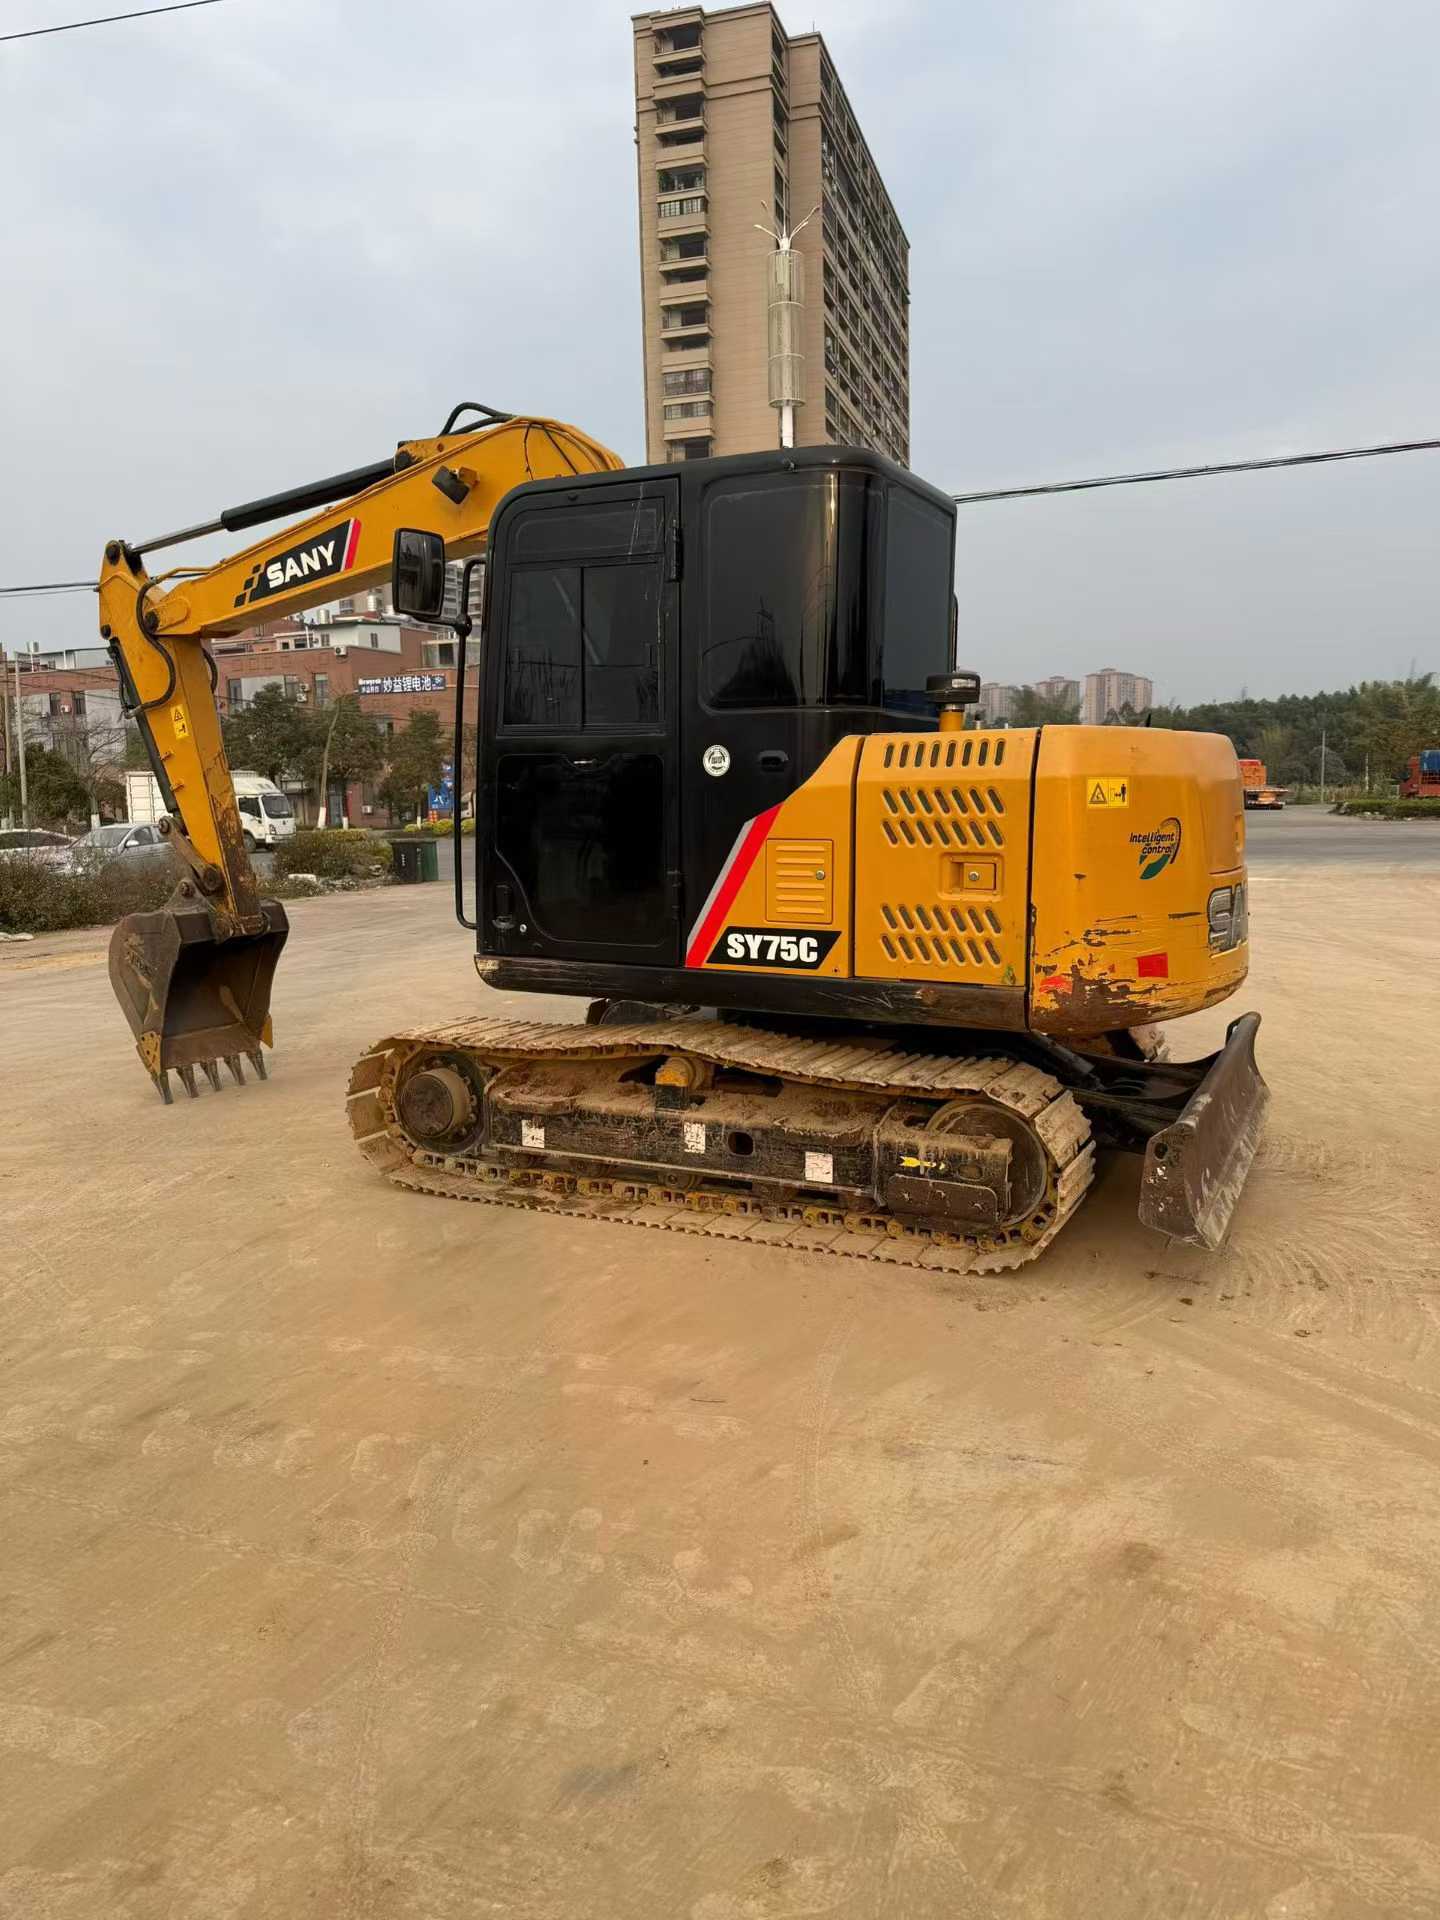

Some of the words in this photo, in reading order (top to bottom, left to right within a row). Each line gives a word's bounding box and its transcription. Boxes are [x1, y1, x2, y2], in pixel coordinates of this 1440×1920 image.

[266, 540, 336, 589] SANY
[1129, 831, 1175, 846] Intelligent
[726, 933, 819, 963] SY75C
